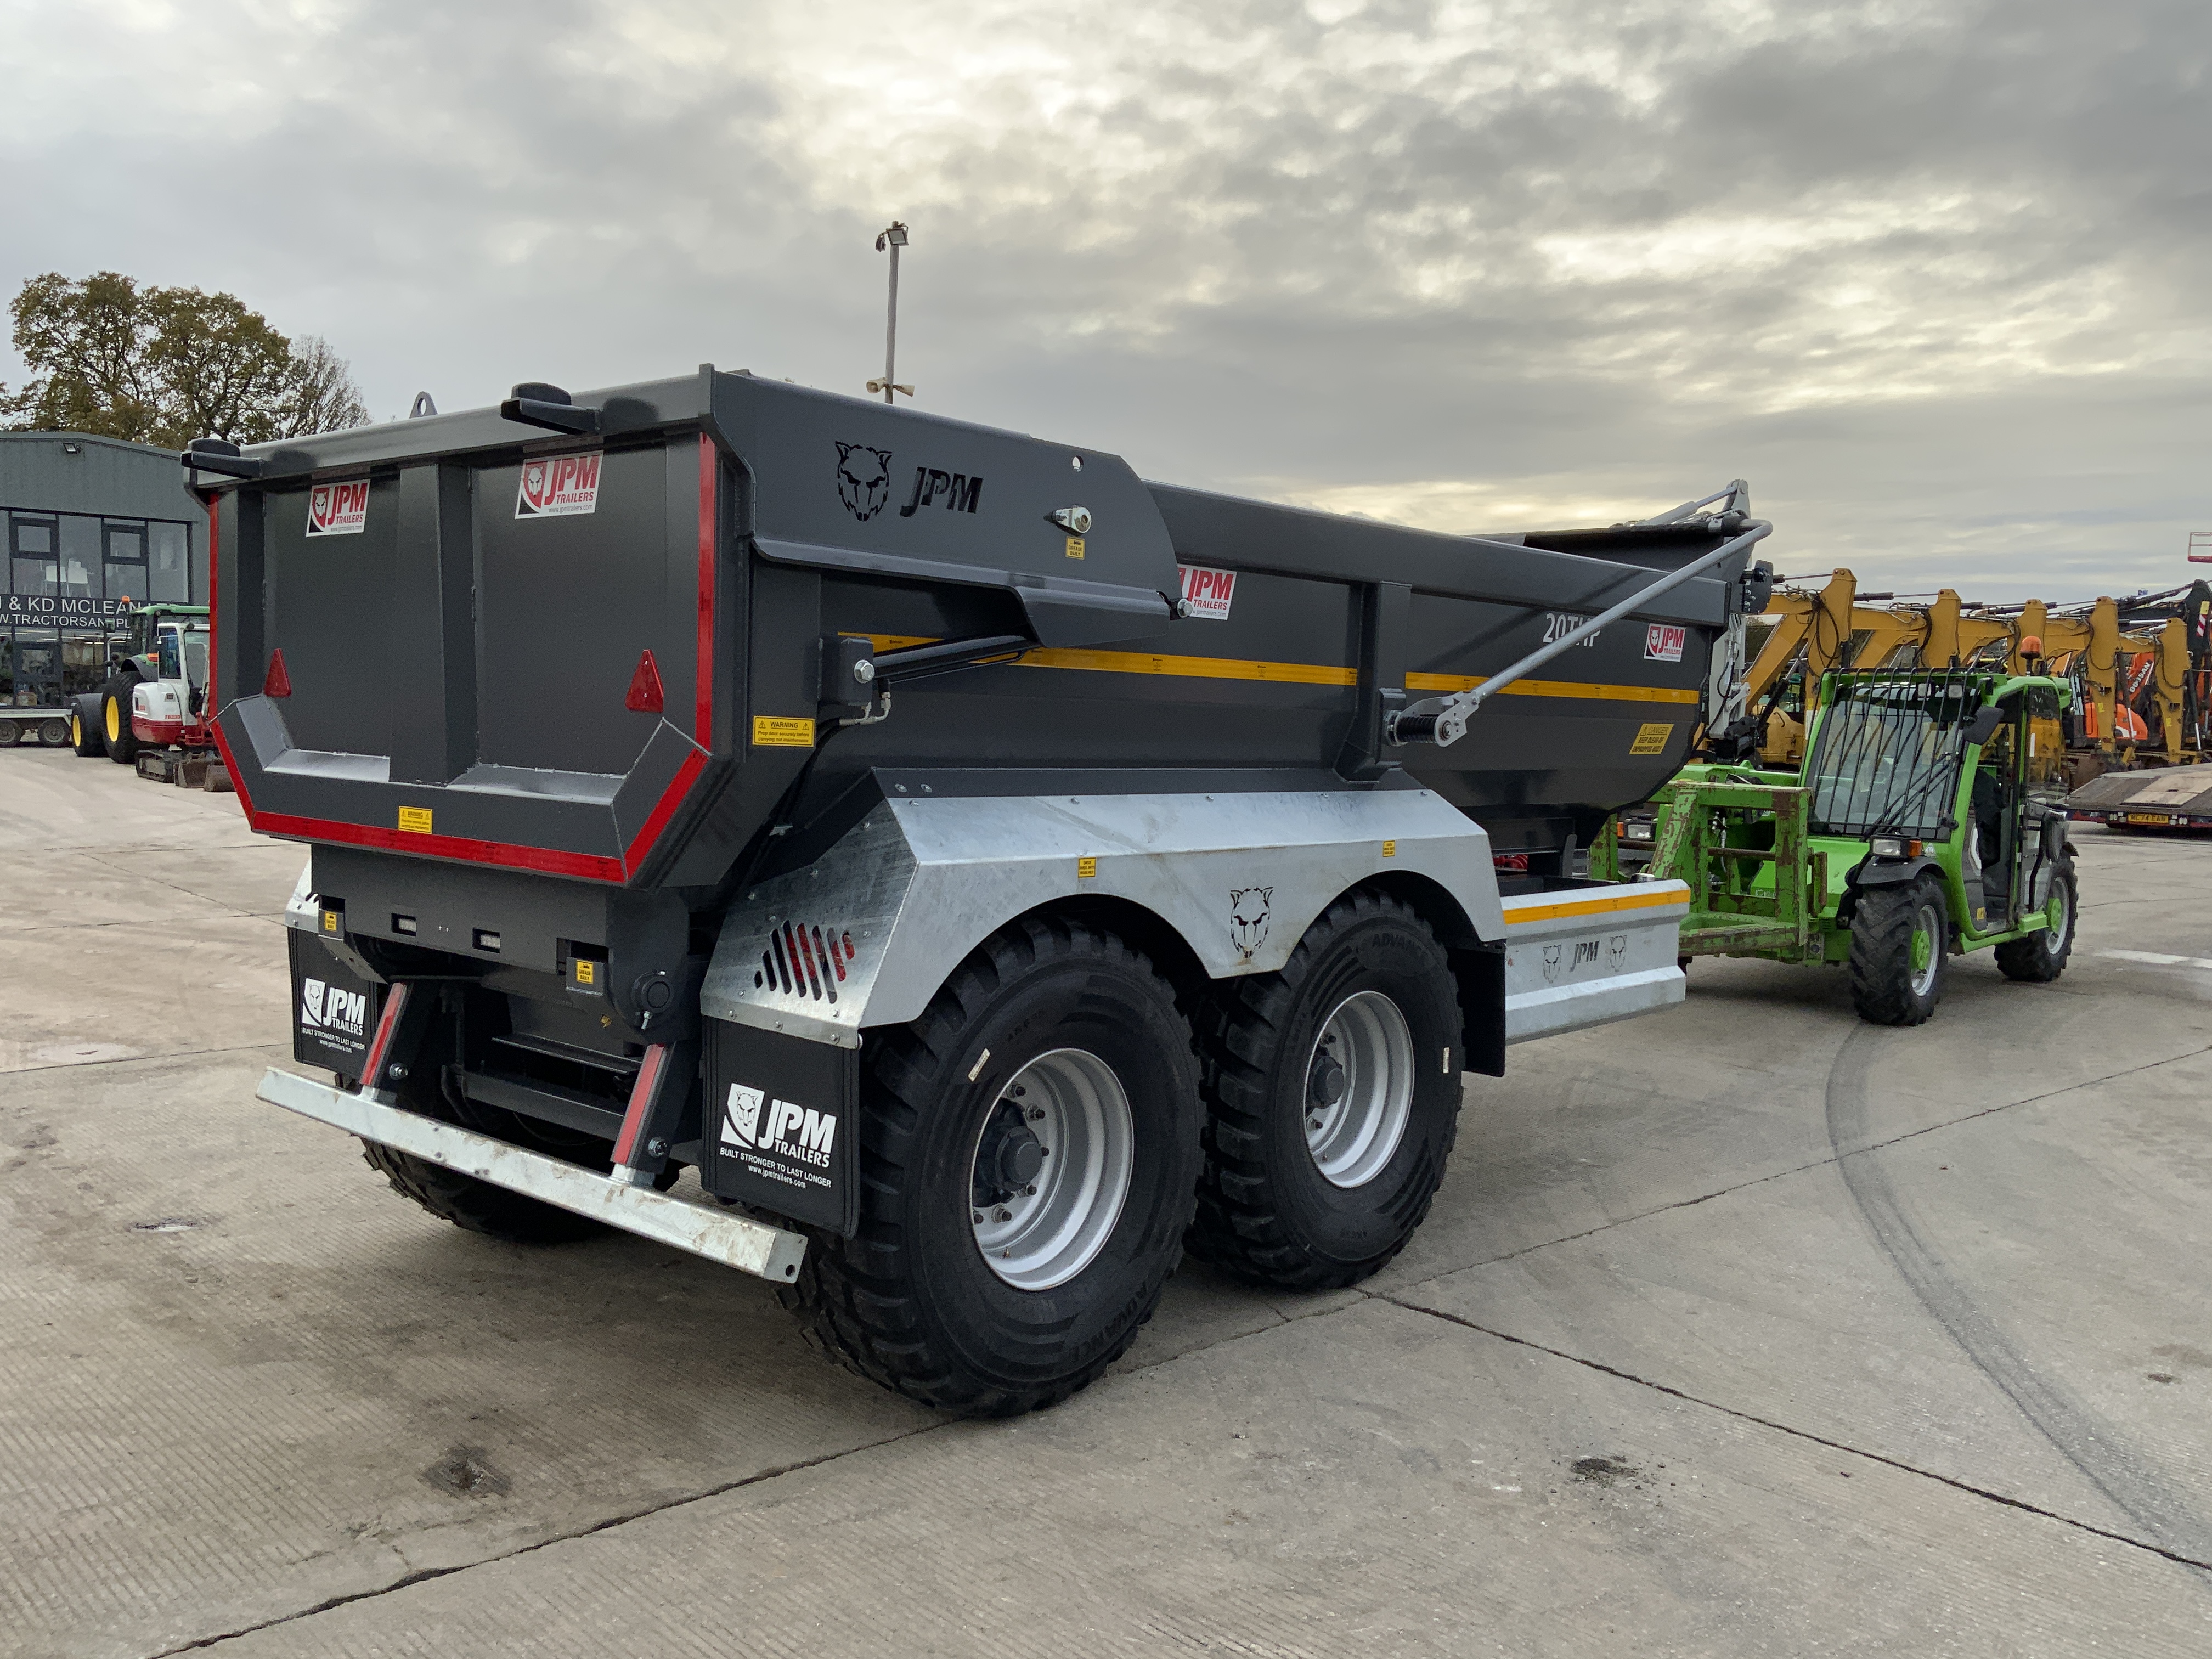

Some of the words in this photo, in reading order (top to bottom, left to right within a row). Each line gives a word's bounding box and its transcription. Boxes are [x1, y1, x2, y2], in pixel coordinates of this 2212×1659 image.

[544, 454, 600, 505] JPM
[899, 466, 983, 517] JPM
[328, 483, 368, 526] JPM
[549, 504, 593, 514] www.jpmtrailers.com
[556, 492, 594, 504] TRAILERS
[336, 515, 363, 524] TRAILERS
[1187, 569, 1234, 602] JPM
[9, 596, 21, 610] &
[29, 597, 54, 611] KD
[1194, 599, 1227, 610] TRAILERS
[1658, 628, 1684, 653] JPM
[1569, 940, 1600, 972] JPM
[323, 988, 366, 1026] JPM
[302, 1027, 313, 1035] BUILT
[314, 1030, 335, 1041] STRONGER
[341, 1037, 350, 1046] LAST
[350, 1040, 365, 1050] LONGER
[332, 1017, 363, 1036] TRAILERS
[758, 1098, 837, 1154] JPM
[774, 1139, 830, 1168] TRAILERS
[720, 1147, 739, 1158] BUILT
[740, 1152, 776, 1169] STRONGER
[777, 1163, 786, 1172] TO
[787, 1166, 803, 1178] LAST
[804, 1172, 832, 1188] LONGER
[748, 1164, 806, 1189] www.jpmtrailers.com
